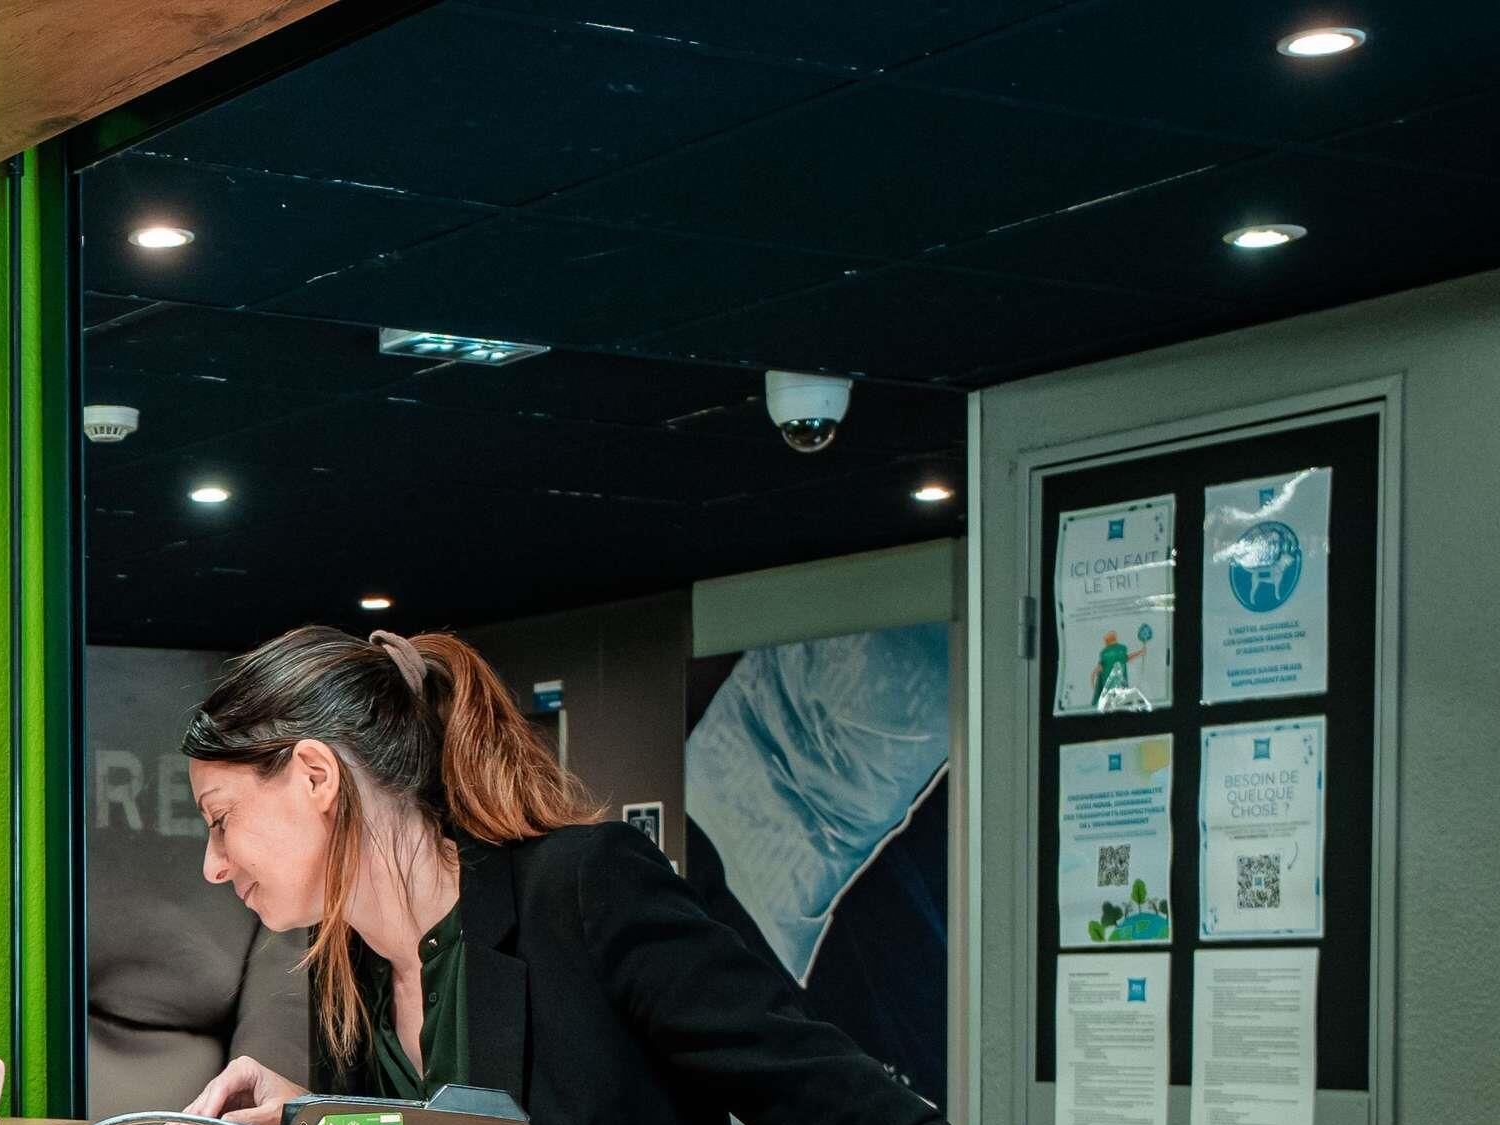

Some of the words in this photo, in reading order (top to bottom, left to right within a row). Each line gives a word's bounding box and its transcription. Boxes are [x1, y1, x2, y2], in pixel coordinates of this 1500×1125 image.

[1070, 560, 1088, 577] ICI
[1094, 557, 1117, 574] ON
[1124, 551, 1158, 566] FAIT
[1084, 579, 1100, 594] LE
[1224, 772, 1275, 788] BESOIN
[1279, 770, 1299, 784] DE
[1227, 786, 1293, 804] QUELQUE
[1231, 802, 1277, 818] CHOSE
